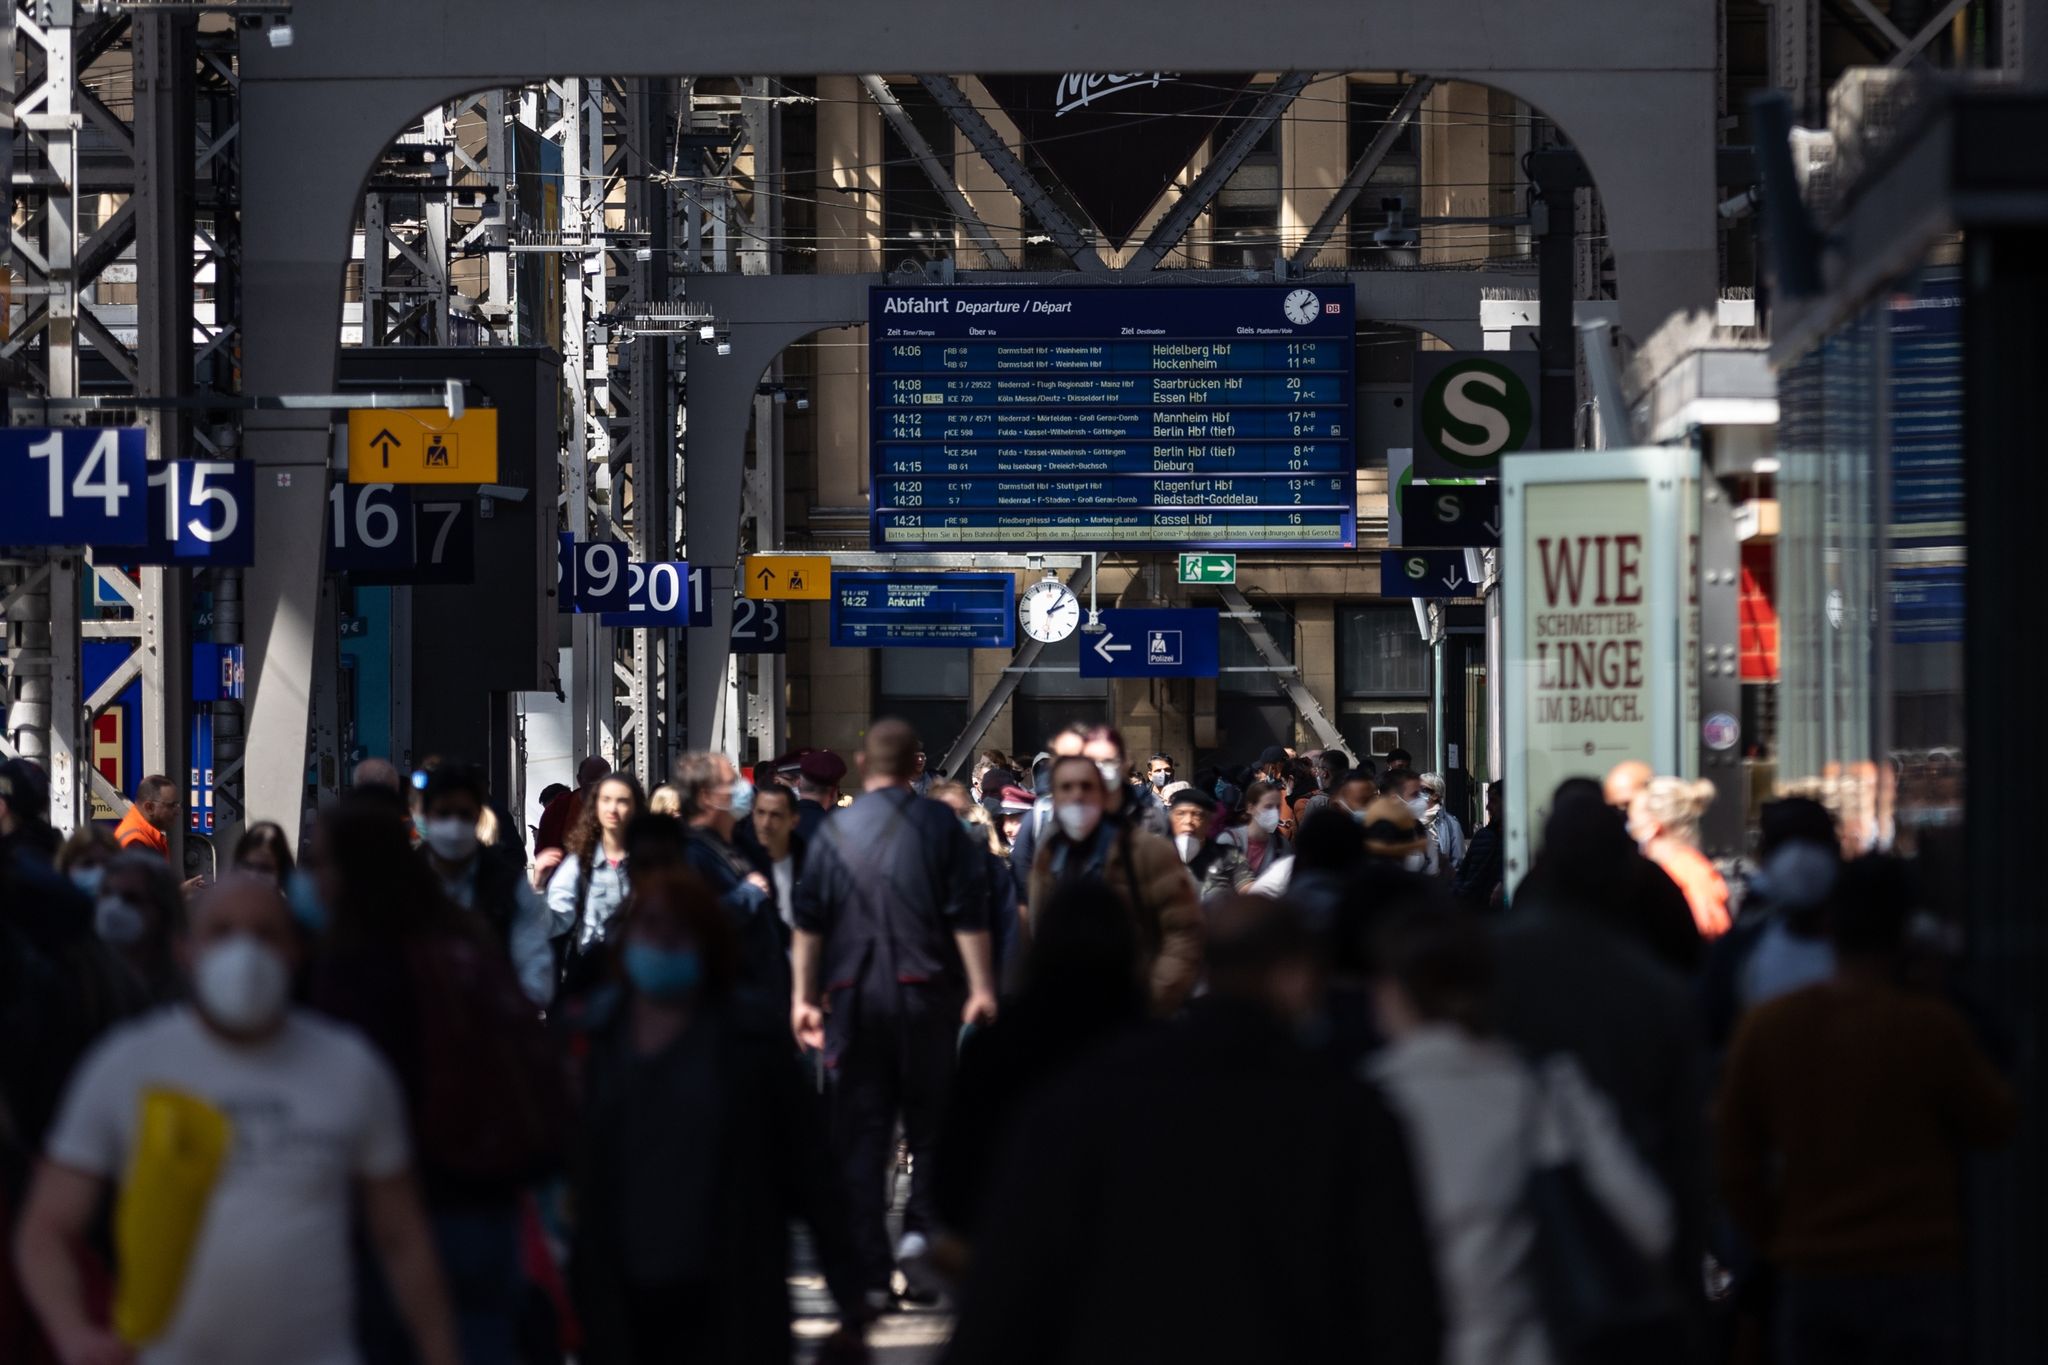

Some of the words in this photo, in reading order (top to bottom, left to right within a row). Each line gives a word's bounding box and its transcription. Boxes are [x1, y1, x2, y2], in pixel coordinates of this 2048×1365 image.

[884, 298, 950, 313] Abfahrt
[956, 300, 1020, 315] Departure
[1032, 301, 1072, 314] Départ
[1327, 304, 1340, 313] DB
[969, 326, 986, 336] Über
[892, 345, 921, 356] 14:06
[1153, 344, 1209, 358] Heidelberg
[1212, 344, 1231, 355] Hbf
[1287, 344, 1299, 355] 11
[1153, 358, 1218, 369] Hockenheim
[1287, 357, 1299, 368] 11
[892, 379, 922, 390] 14:08
[1153, 378, 1221, 389] Saarbrücken
[1224, 378, 1243, 389] Hbf
[1286, 378, 1300, 389] 20
[893, 393, 922, 404] 14:10
[1153, 392, 1186, 403] Essen
[1189, 392, 1208, 402] Hbf
[1293, 391, 1301, 402] 7
[892, 413, 922, 424] 14:12
[1153, 412, 1208, 423] Mannheim
[1212, 412, 1230, 423] Hbf
[1288, 412, 1301, 422] 17
[1441, 371, 1510, 456] S
[893, 427, 922, 438] 14:14
[1092, 428, 1126, 436] Göttingen
[1154, 426, 1184, 436] Berlin
[1188, 426, 1206, 436] Hbf
[1210, 425, 1235, 436] (tief)
[1293, 425, 1301, 436] 8
[1093, 448, 1126, 457] Göttingen
[1153, 446, 1184, 457] Berlin
[1188, 446, 1206, 457] Hbf
[1210, 446, 1236, 457] (tief)
[1293, 445, 1301, 456] 8
[893, 461, 922, 472] 14:15
[1012, 463, 1042, 472] Isenburg
[1154, 460, 1194, 472] Dieburg
[1288, 459, 1301, 470] 10
[29, 430, 129, 517] 14
[893, 481, 922, 492] 14:20
[960, 482, 972, 490] 117
[1056, 482, 1089, 492] Stuttgart
[1154, 480, 1211, 493] Klagenfurt
[1214, 480, 1233, 490] Hbf
[1288, 479, 1301, 490] 13
[148, 462, 238, 542] 15
[893, 495, 922, 506] 14:20
[1154, 494, 1258, 504] Riedstadt-Goddelau
[1294, 493, 1301, 504] 2
[1438, 494, 1460, 522] S
[330, 483, 399, 548] 16
[893, 515, 921, 526] 14:21
[1154, 514, 1190, 525] Kassel
[1194, 514, 1212, 524] Hbf
[1288, 513, 1301, 524] 16
[1408, 558, 1426, 578] S
[1537, 534, 1643, 607] WIE
[629, 563, 680, 612] 20
[842, 597, 867, 607] 14:22
[887, 597, 925, 607] Ankunft
[1536, 612, 1644, 637] SCHMETTER-
[1151, 654, 1174, 663] Polizei
[1536, 640, 1644, 690] LINGE
[1537, 697, 1564, 723] IM
[1569, 694, 1644, 722] BAUCH.
